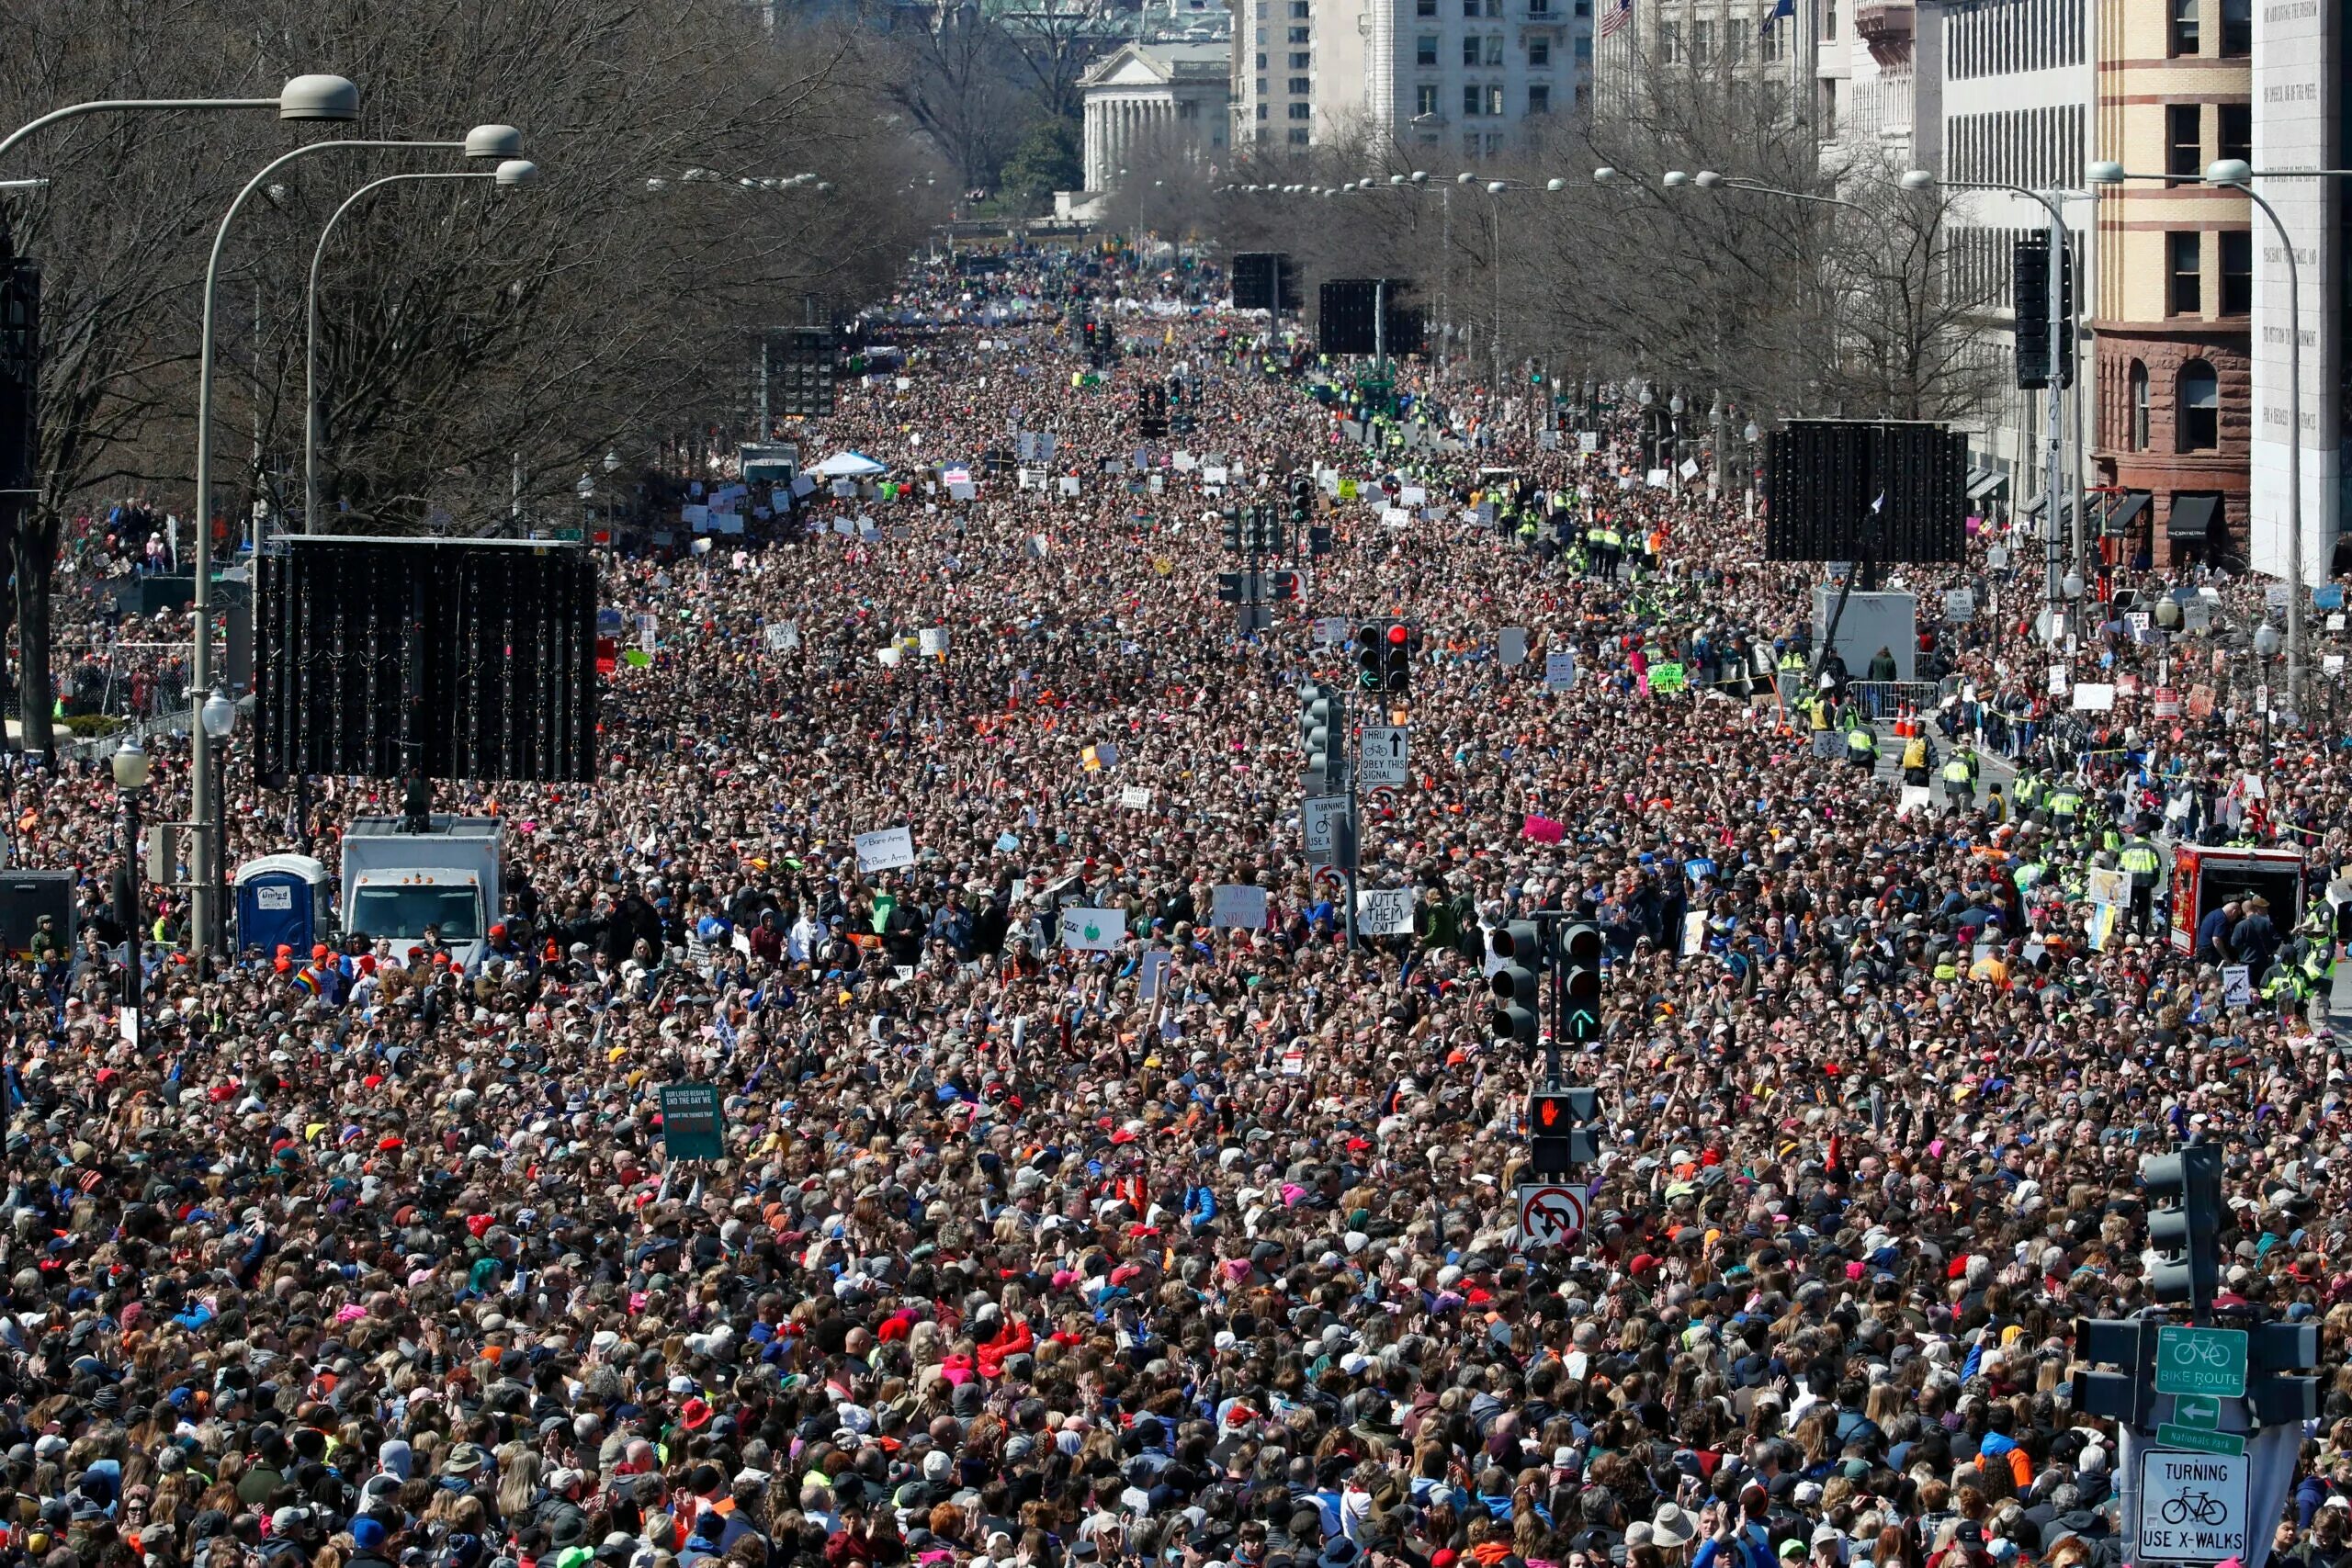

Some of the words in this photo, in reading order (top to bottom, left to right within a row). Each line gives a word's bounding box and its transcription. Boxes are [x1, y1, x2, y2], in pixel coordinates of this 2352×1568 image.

[1364, 731, 1385, 739] THRU
[1363, 760, 1384, 769] OBEY
[1388, 760, 1404, 768] THIS
[1363, 771, 1392, 780] SIGNAL
[1315, 801, 1345, 812] TURNING
[1309, 837, 1322, 846] USE
[1692, 863, 1710, 874] NOT
[1366, 893, 1402, 907] VOTE
[1368, 907, 1403, 921] THEM
[1371, 921, 1399, 933] OUT
[2161, 1371, 2190, 1382] BIKE
[2195, 1372, 2240, 1385] ROUTE
[2171, 1432, 2209, 1446] Nationals
[2212, 1438, 2231, 1449] Park
[2165, 1464, 2227, 1481] TURNING
[2143, 1531, 2172, 1547] USE
[2179, 1532, 2242, 1549] X-WALKS
